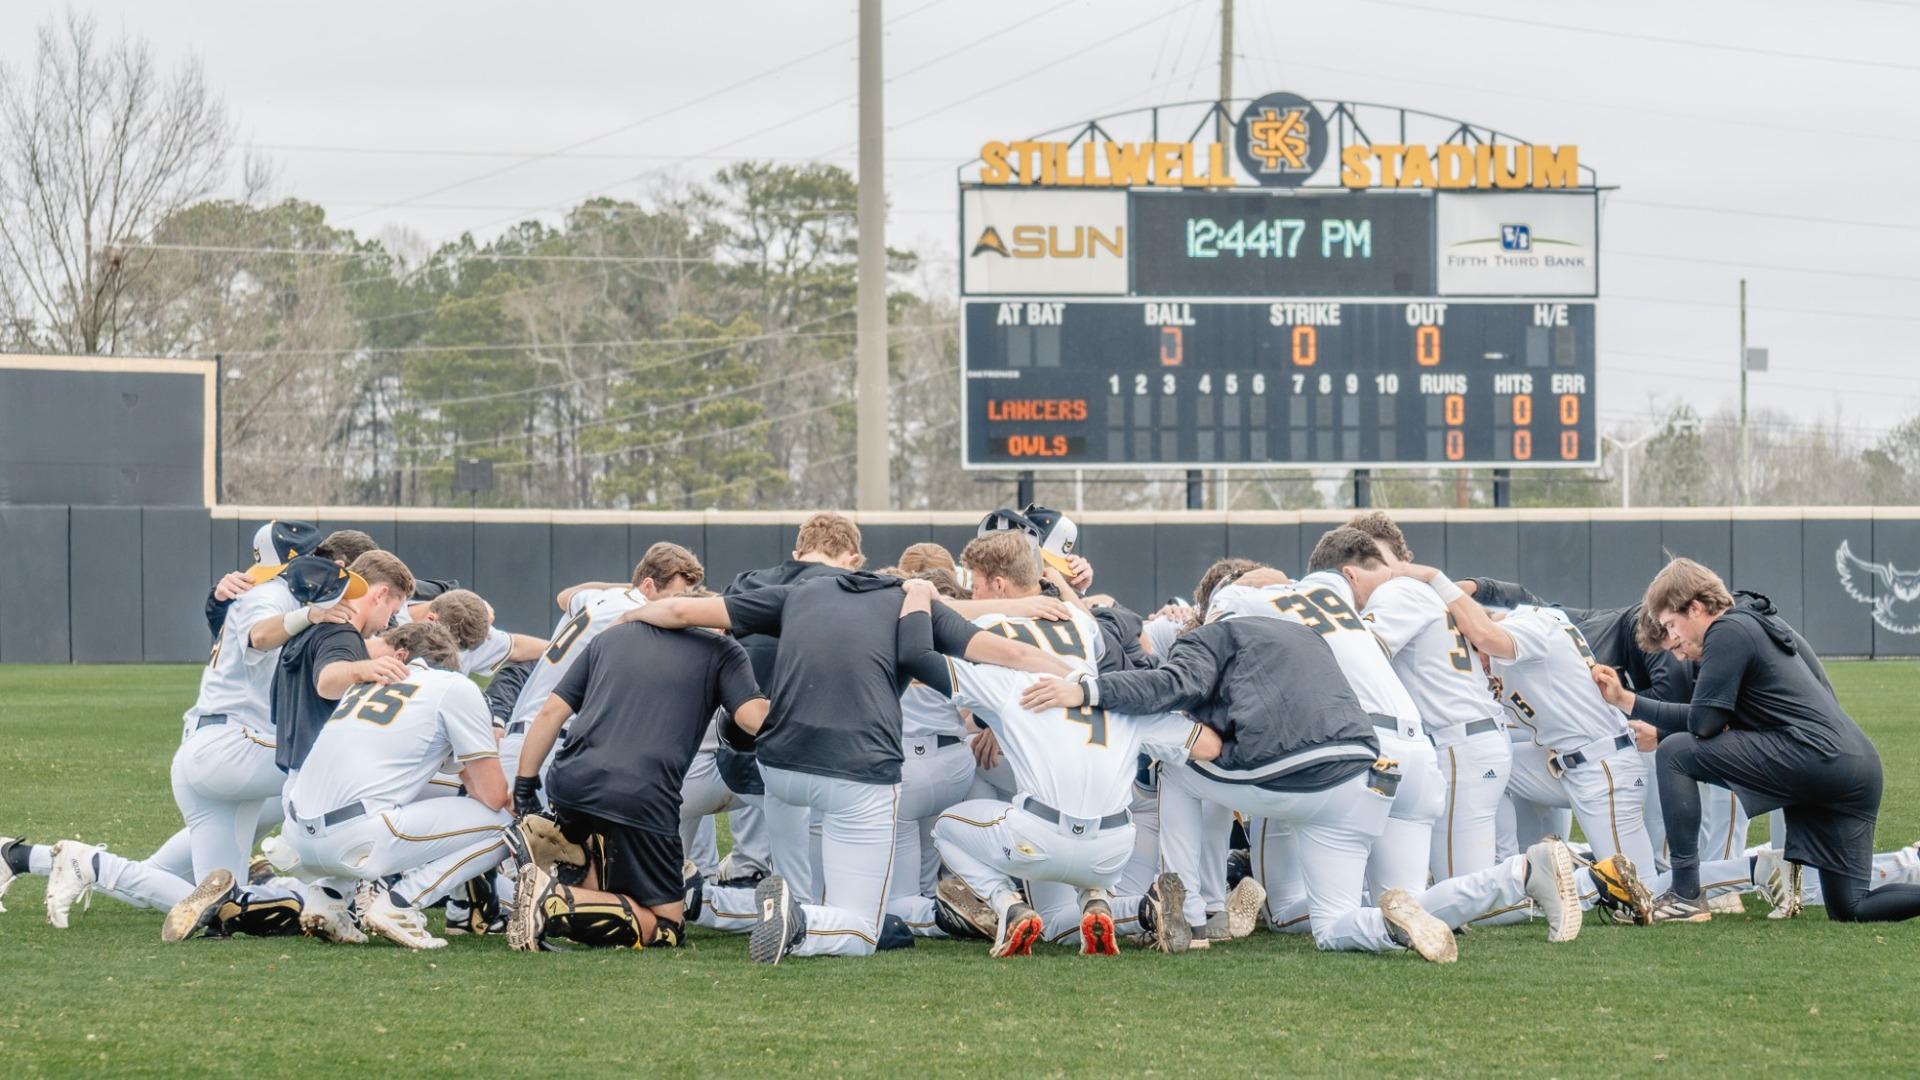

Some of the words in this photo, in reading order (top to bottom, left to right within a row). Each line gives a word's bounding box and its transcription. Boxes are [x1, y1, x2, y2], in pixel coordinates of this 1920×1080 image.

[980, 141, 1236, 187] STILLWELL
[1341, 143, 1579, 189] STADIUM
[970, 225, 1124, 259] ASUN
[1322, 219, 1372, 258] PM
[997, 303, 1023, 325] AT
[1027, 303, 1066, 325] BAT
[1145, 303, 1196, 326] BALL
[1270, 303, 1342, 326] STRIKE
[1406, 304, 1448, 326] OUT
[1534, 304, 1569, 326] H/E
[1292, 326, 1317, 367] 0
[1416, 326, 1441, 367] 0
[1109, 373, 1120, 395] 1
[1135, 373, 1148, 395] 2
[1163, 373, 1177, 395] 3
[1198, 373, 1212, 395] 4
[1225, 373, 1239, 395] 5
[1252, 373, 1266, 395] 6
[1292, 373, 1305, 395] 7
[1318, 373, 1332, 395] 8
[1345, 373, 1359, 395] 9
[1376, 373, 1400, 395] 10
[1420, 373, 1468, 395] RUNS
[1494, 373, 1534, 395] HITS
[1551, 373, 1586, 395] ERR
[988, 399, 1088, 422] LANCERS
[1445, 394, 1465, 426] 0
[1513, 394, 1532, 426] 0
[1560, 394, 1579, 426] 0
[1008, 434, 1069, 457] OWLS
[1446, 429, 1464, 460] 0
[1513, 429, 1532, 460] 0
[1561, 429, 1579, 460] 0
[1271, 587, 1366, 634] 39
